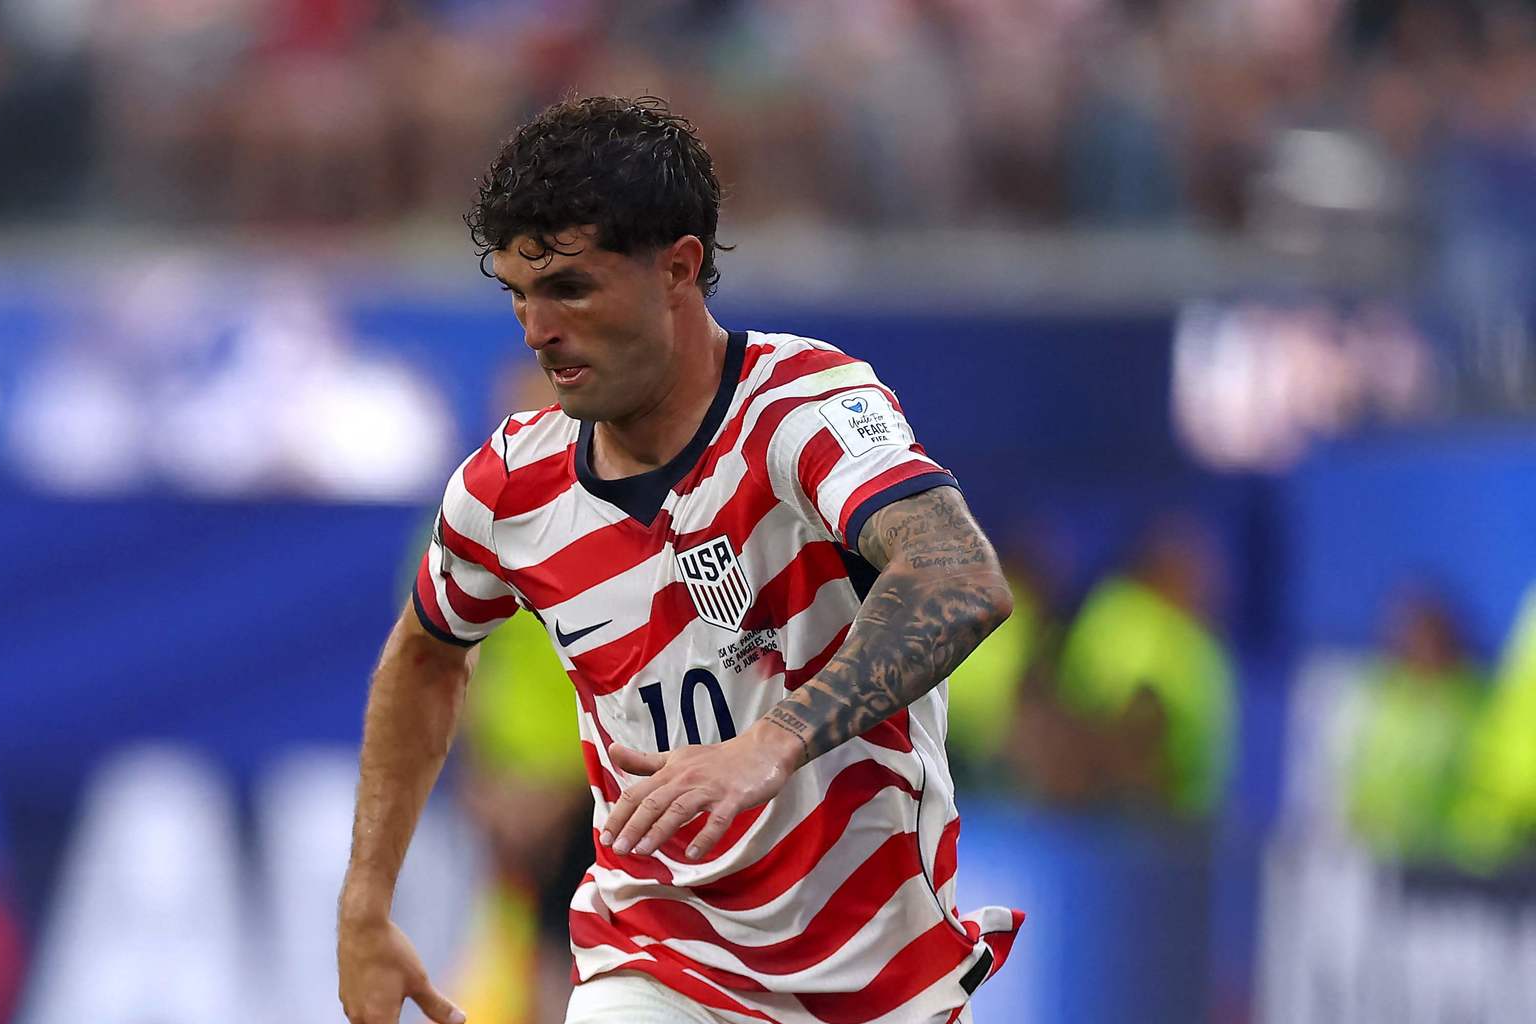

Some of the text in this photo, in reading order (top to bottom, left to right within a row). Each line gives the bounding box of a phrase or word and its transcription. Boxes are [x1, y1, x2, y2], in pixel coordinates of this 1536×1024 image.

[848, 414, 871, 429] Unite
[857, 422, 891, 438] PEACE
[871, 435, 888, 443] FIFA
[682, 540, 732, 581] USA
[718, 647, 728, 658] SA
[742, 651, 761, 668] JUNE
[723, 656, 736, 669] LOS
[638, 667, 737, 753] 10
